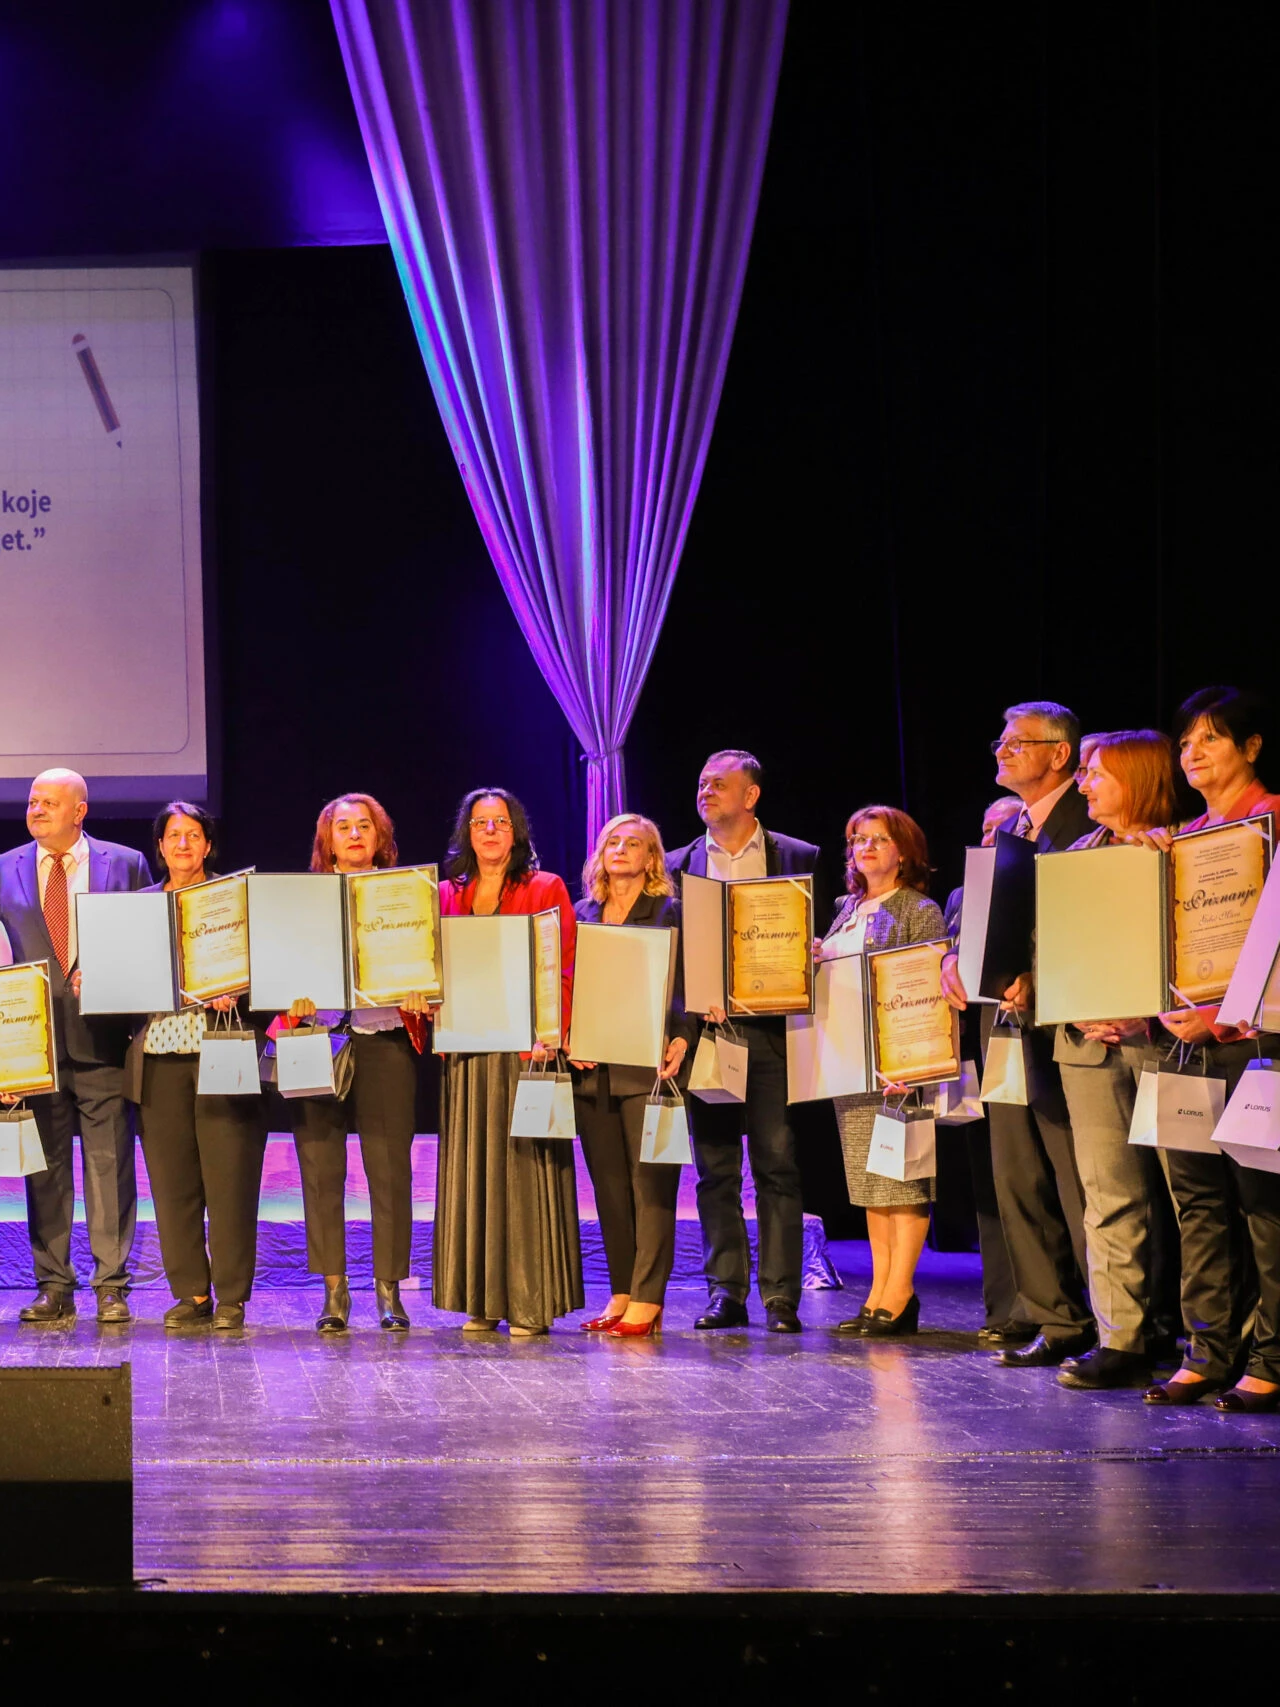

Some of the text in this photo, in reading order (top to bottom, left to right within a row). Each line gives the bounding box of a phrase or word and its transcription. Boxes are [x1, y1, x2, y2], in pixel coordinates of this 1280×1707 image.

[2, 489, 52, 518] koje
[1183, 884, 1257, 911] Priznanje
[740, 925, 801, 941] Priznanje
